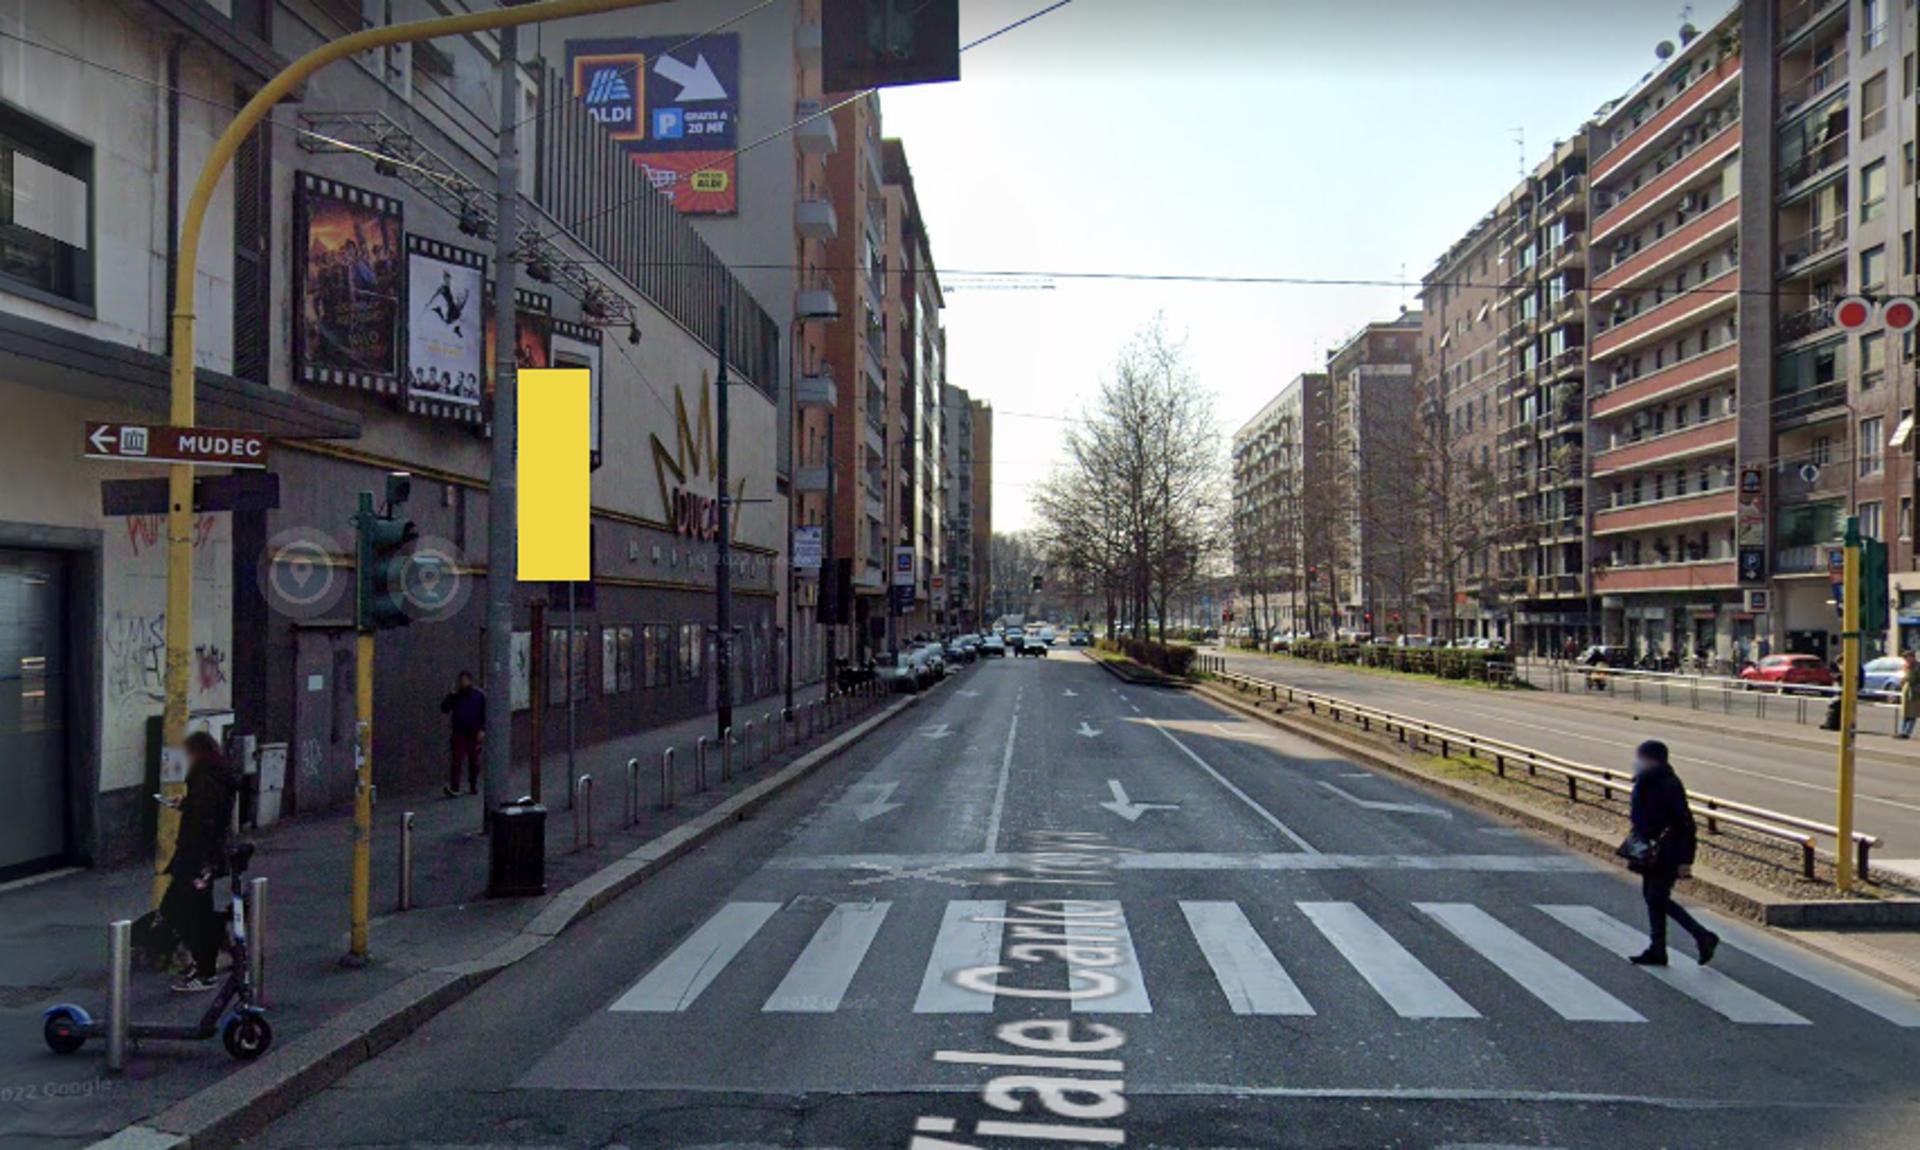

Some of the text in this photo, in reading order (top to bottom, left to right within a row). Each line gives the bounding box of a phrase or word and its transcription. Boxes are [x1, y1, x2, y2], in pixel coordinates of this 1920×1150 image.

[588, 106, 632, 122] ALDI
[684, 111, 728, 121] GRATIS A
[659, 114, 677, 134] P
[687, 121, 725, 134] 20 MT
[178, 435, 262, 456] MUDEC
[676, 486, 722, 540] DUCA
